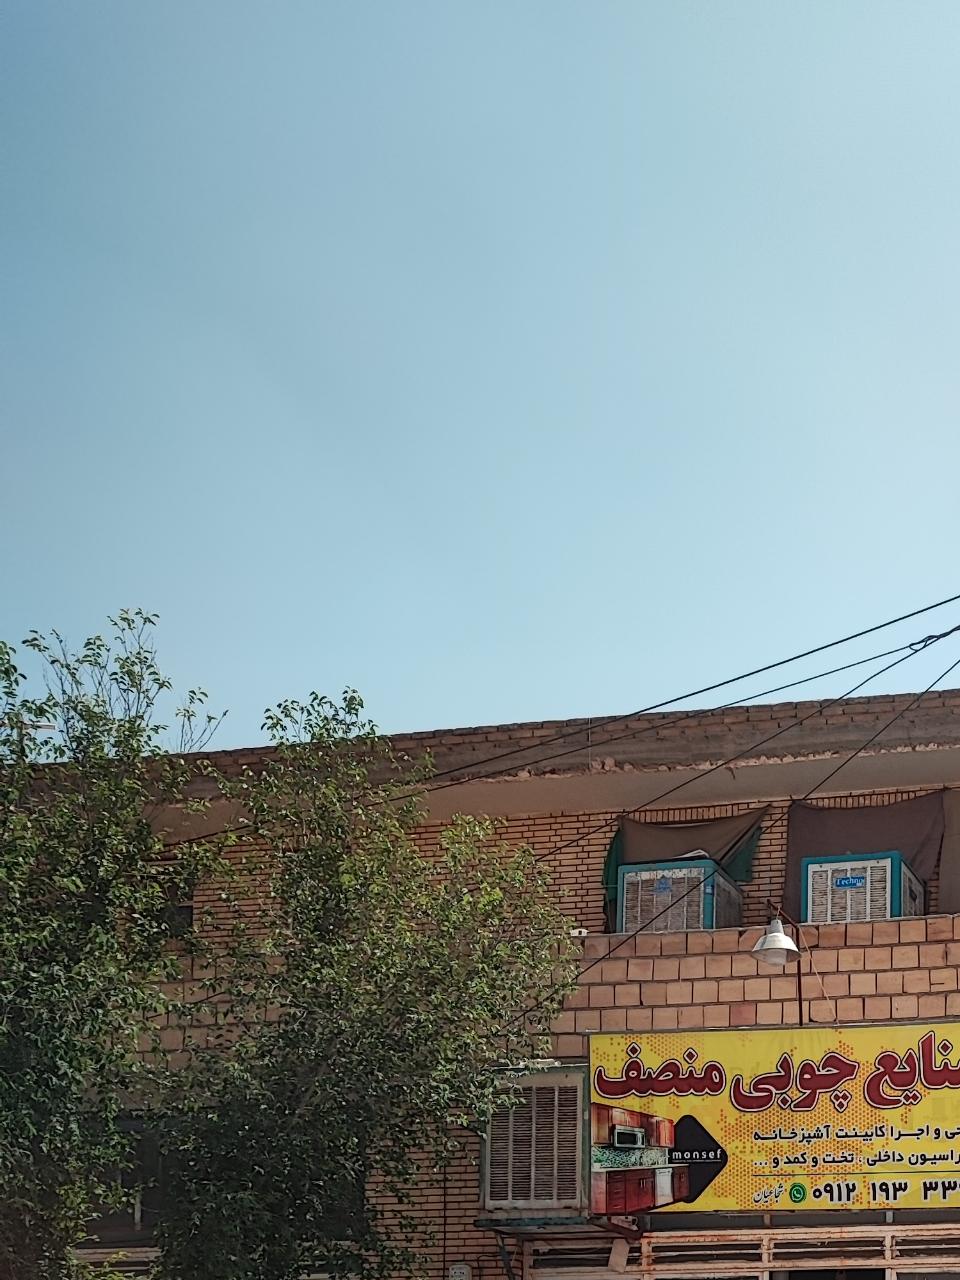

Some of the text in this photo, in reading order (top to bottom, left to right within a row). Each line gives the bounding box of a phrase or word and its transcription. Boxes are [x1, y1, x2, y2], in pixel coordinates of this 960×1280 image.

[592, 1041, 727, 1099] منصف
[730, 1050, 860, 1113] چوبی
[753, 1125, 831, 1145] آشپزخانه
[835, 1125, 886, 1142] کابینت
[890, 1125, 930, 1139] اجرا
[933, 1127, 941, 1139] و
[672, 1149, 722, 1160] monsef
[784, 1152, 807, 1165] کمد
[811, 1155, 819, 1167] و
[822, 1153, 855, 1165] تخت
[866, 1150, 904, 1166] داخلی
[772, 1156, 779, 1168] و
[812, 1182, 857, 1202] ۰۹۱۲
[870, 1181, 909, 1201] ۱۹۳
